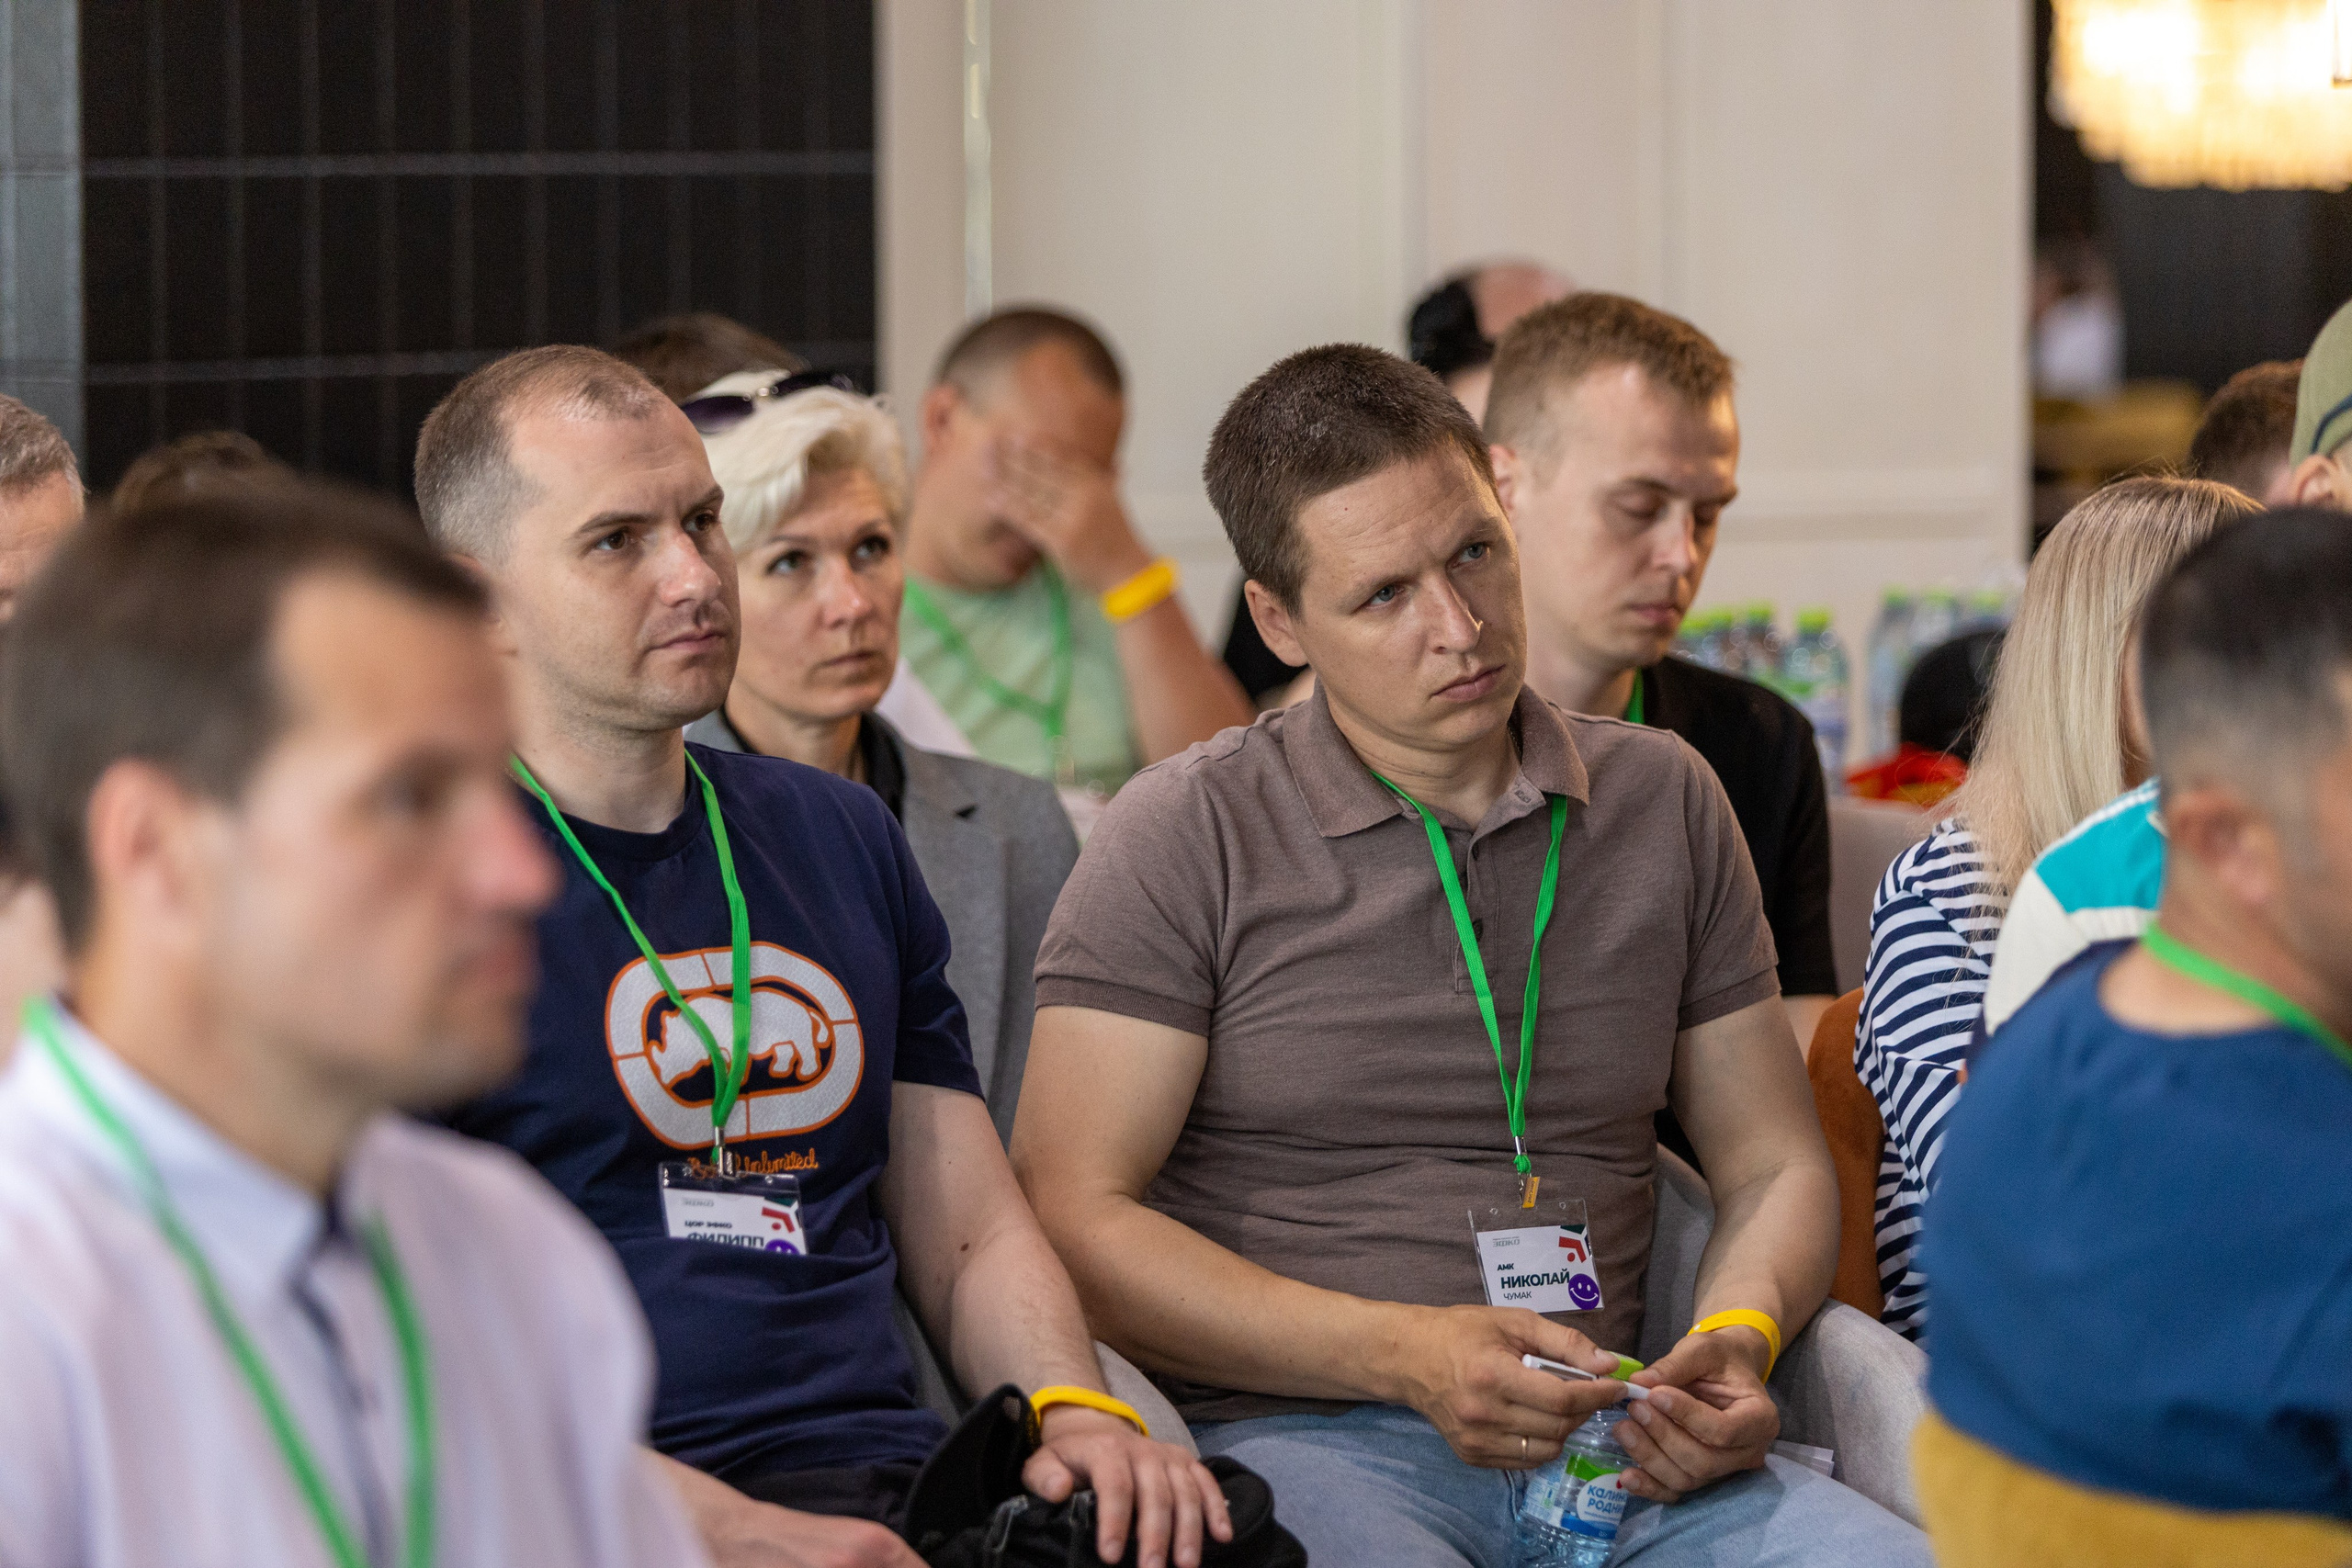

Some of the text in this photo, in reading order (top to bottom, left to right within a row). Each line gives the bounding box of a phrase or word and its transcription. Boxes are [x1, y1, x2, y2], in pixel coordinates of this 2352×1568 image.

[1498, 1263, 1514, 1271] АМК
[1500, 1269, 1570, 1289] НИКОЛАЙ
[1503, 1291, 1532, 1301] ЧУМАК
